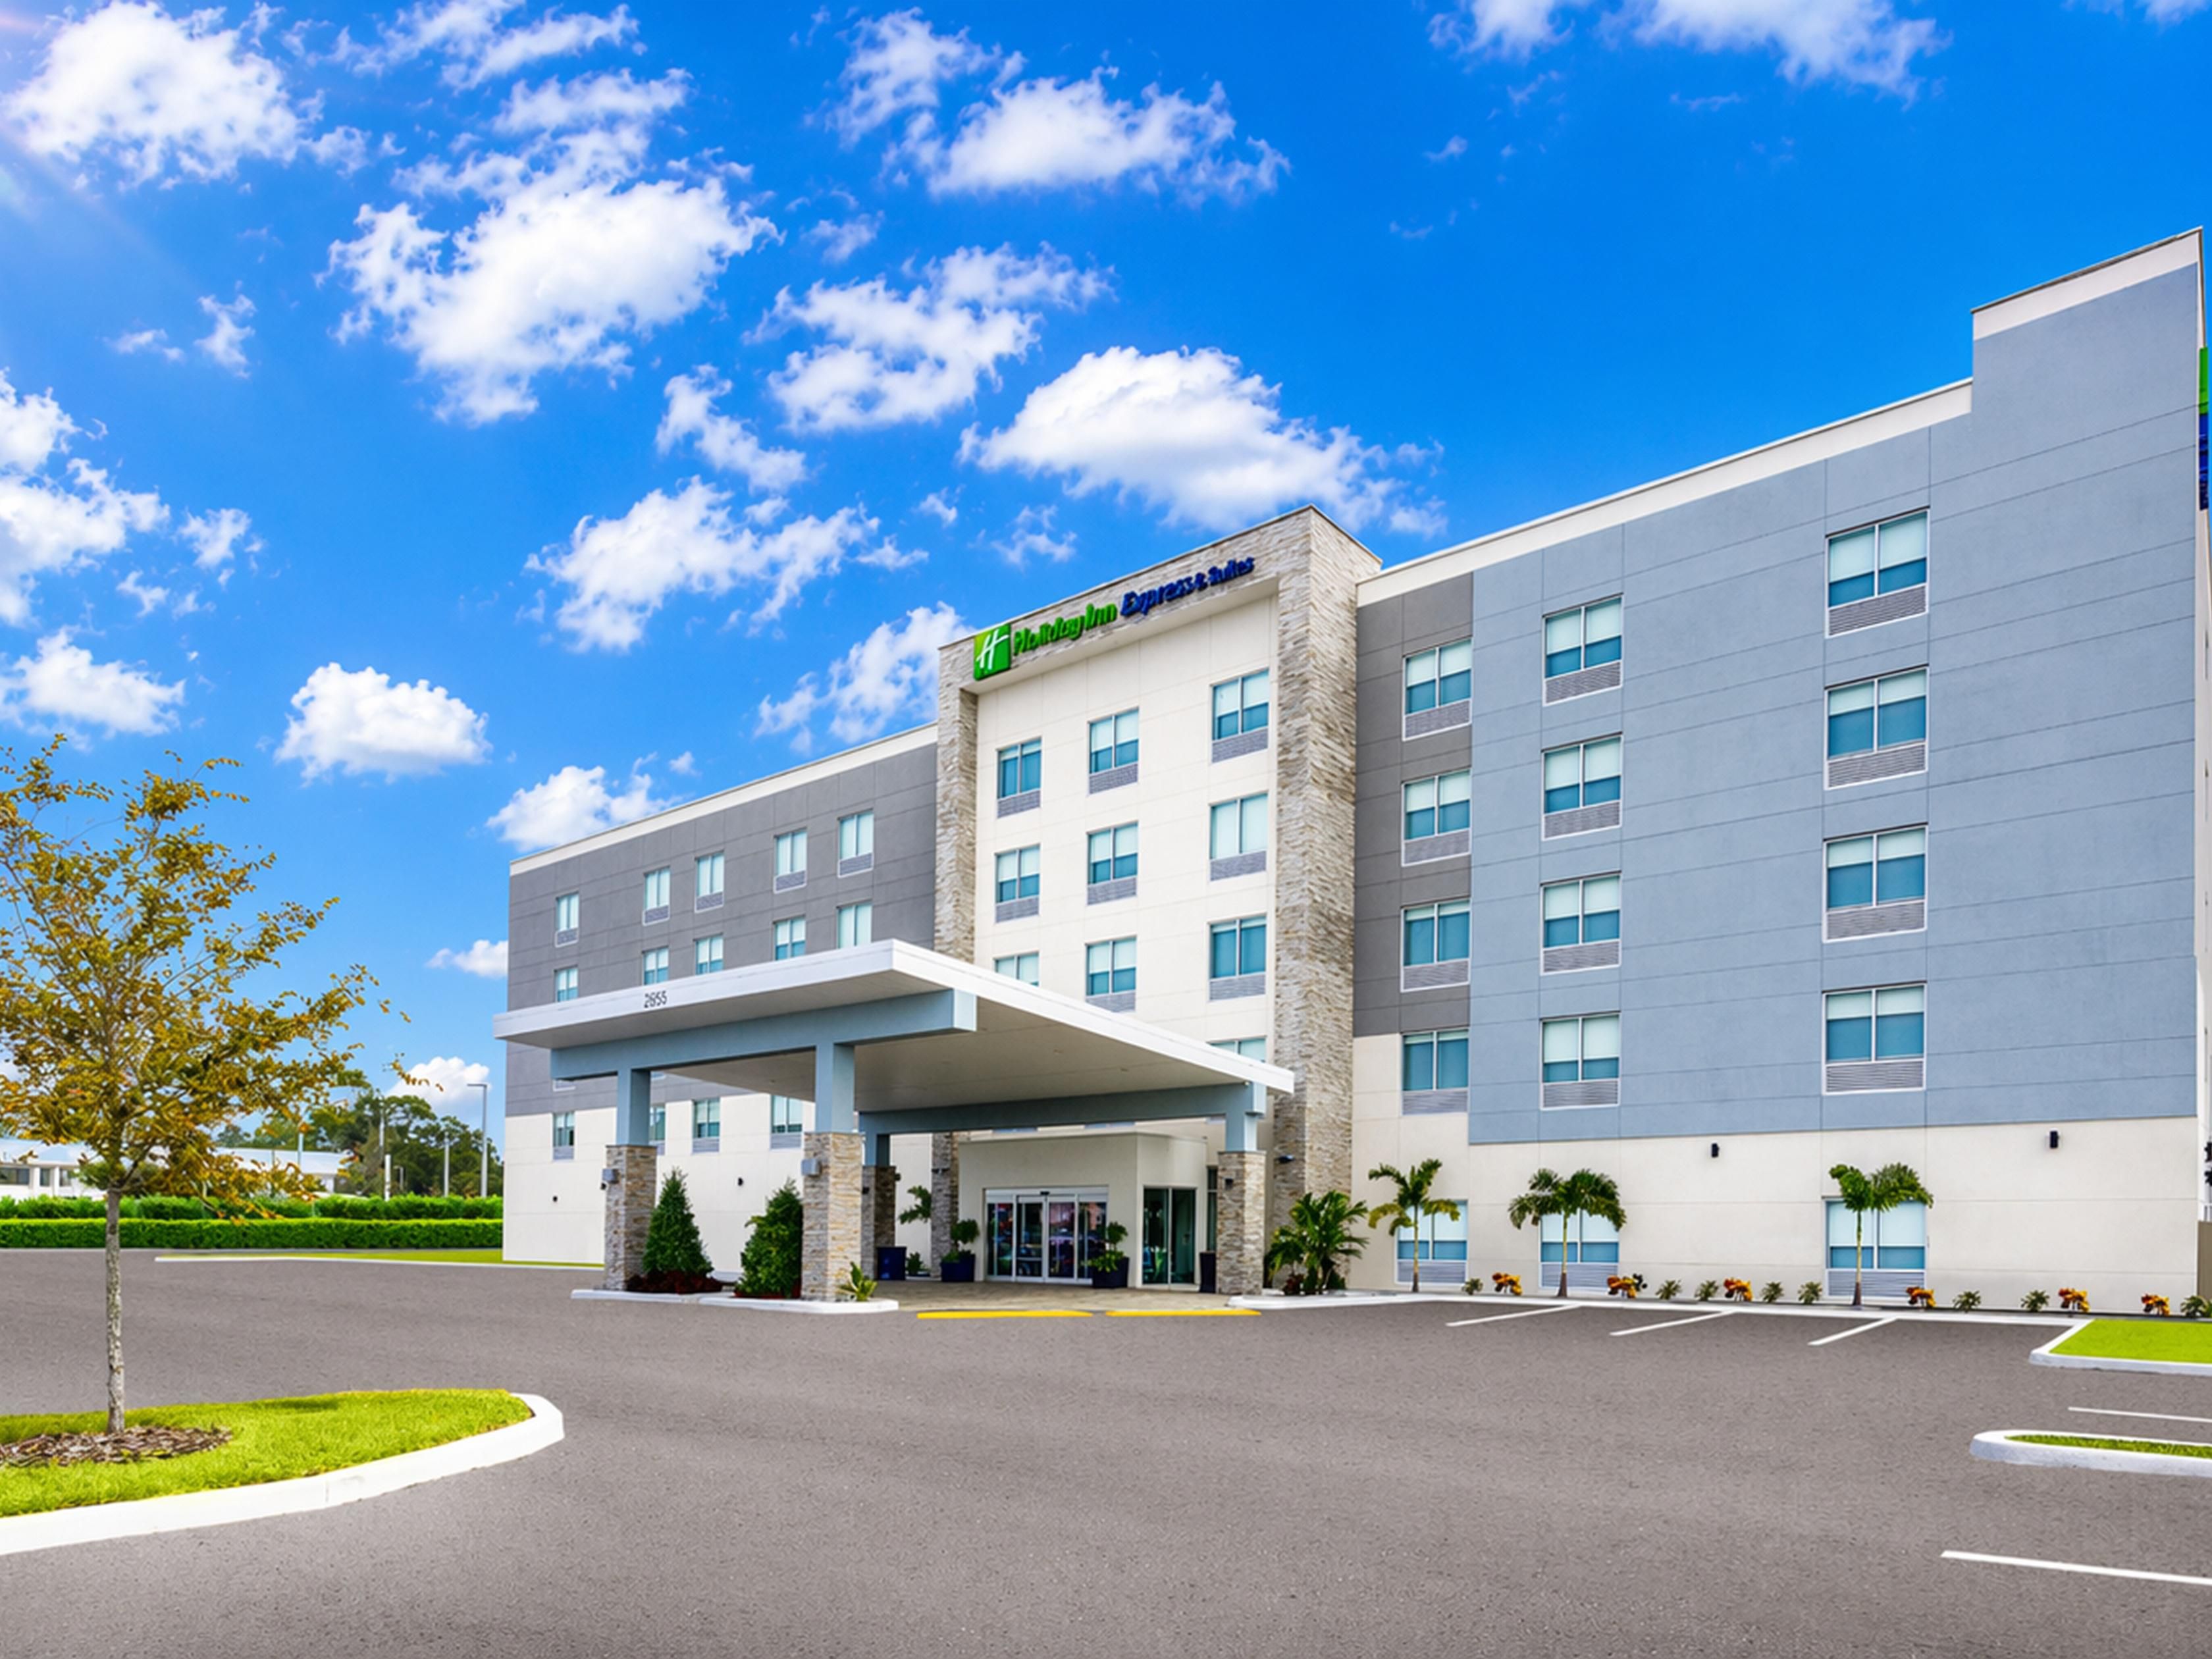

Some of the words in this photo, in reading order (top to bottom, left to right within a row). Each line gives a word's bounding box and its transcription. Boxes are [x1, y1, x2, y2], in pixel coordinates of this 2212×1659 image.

[1013, 615, 1085, 656] Holiday
[1085, 602, 1118, 631] Inn
[1120, 577, 1195, 616] Express
[1194, 572, 1208, 591] &
[1208, 556, 1255, 586] Suites
